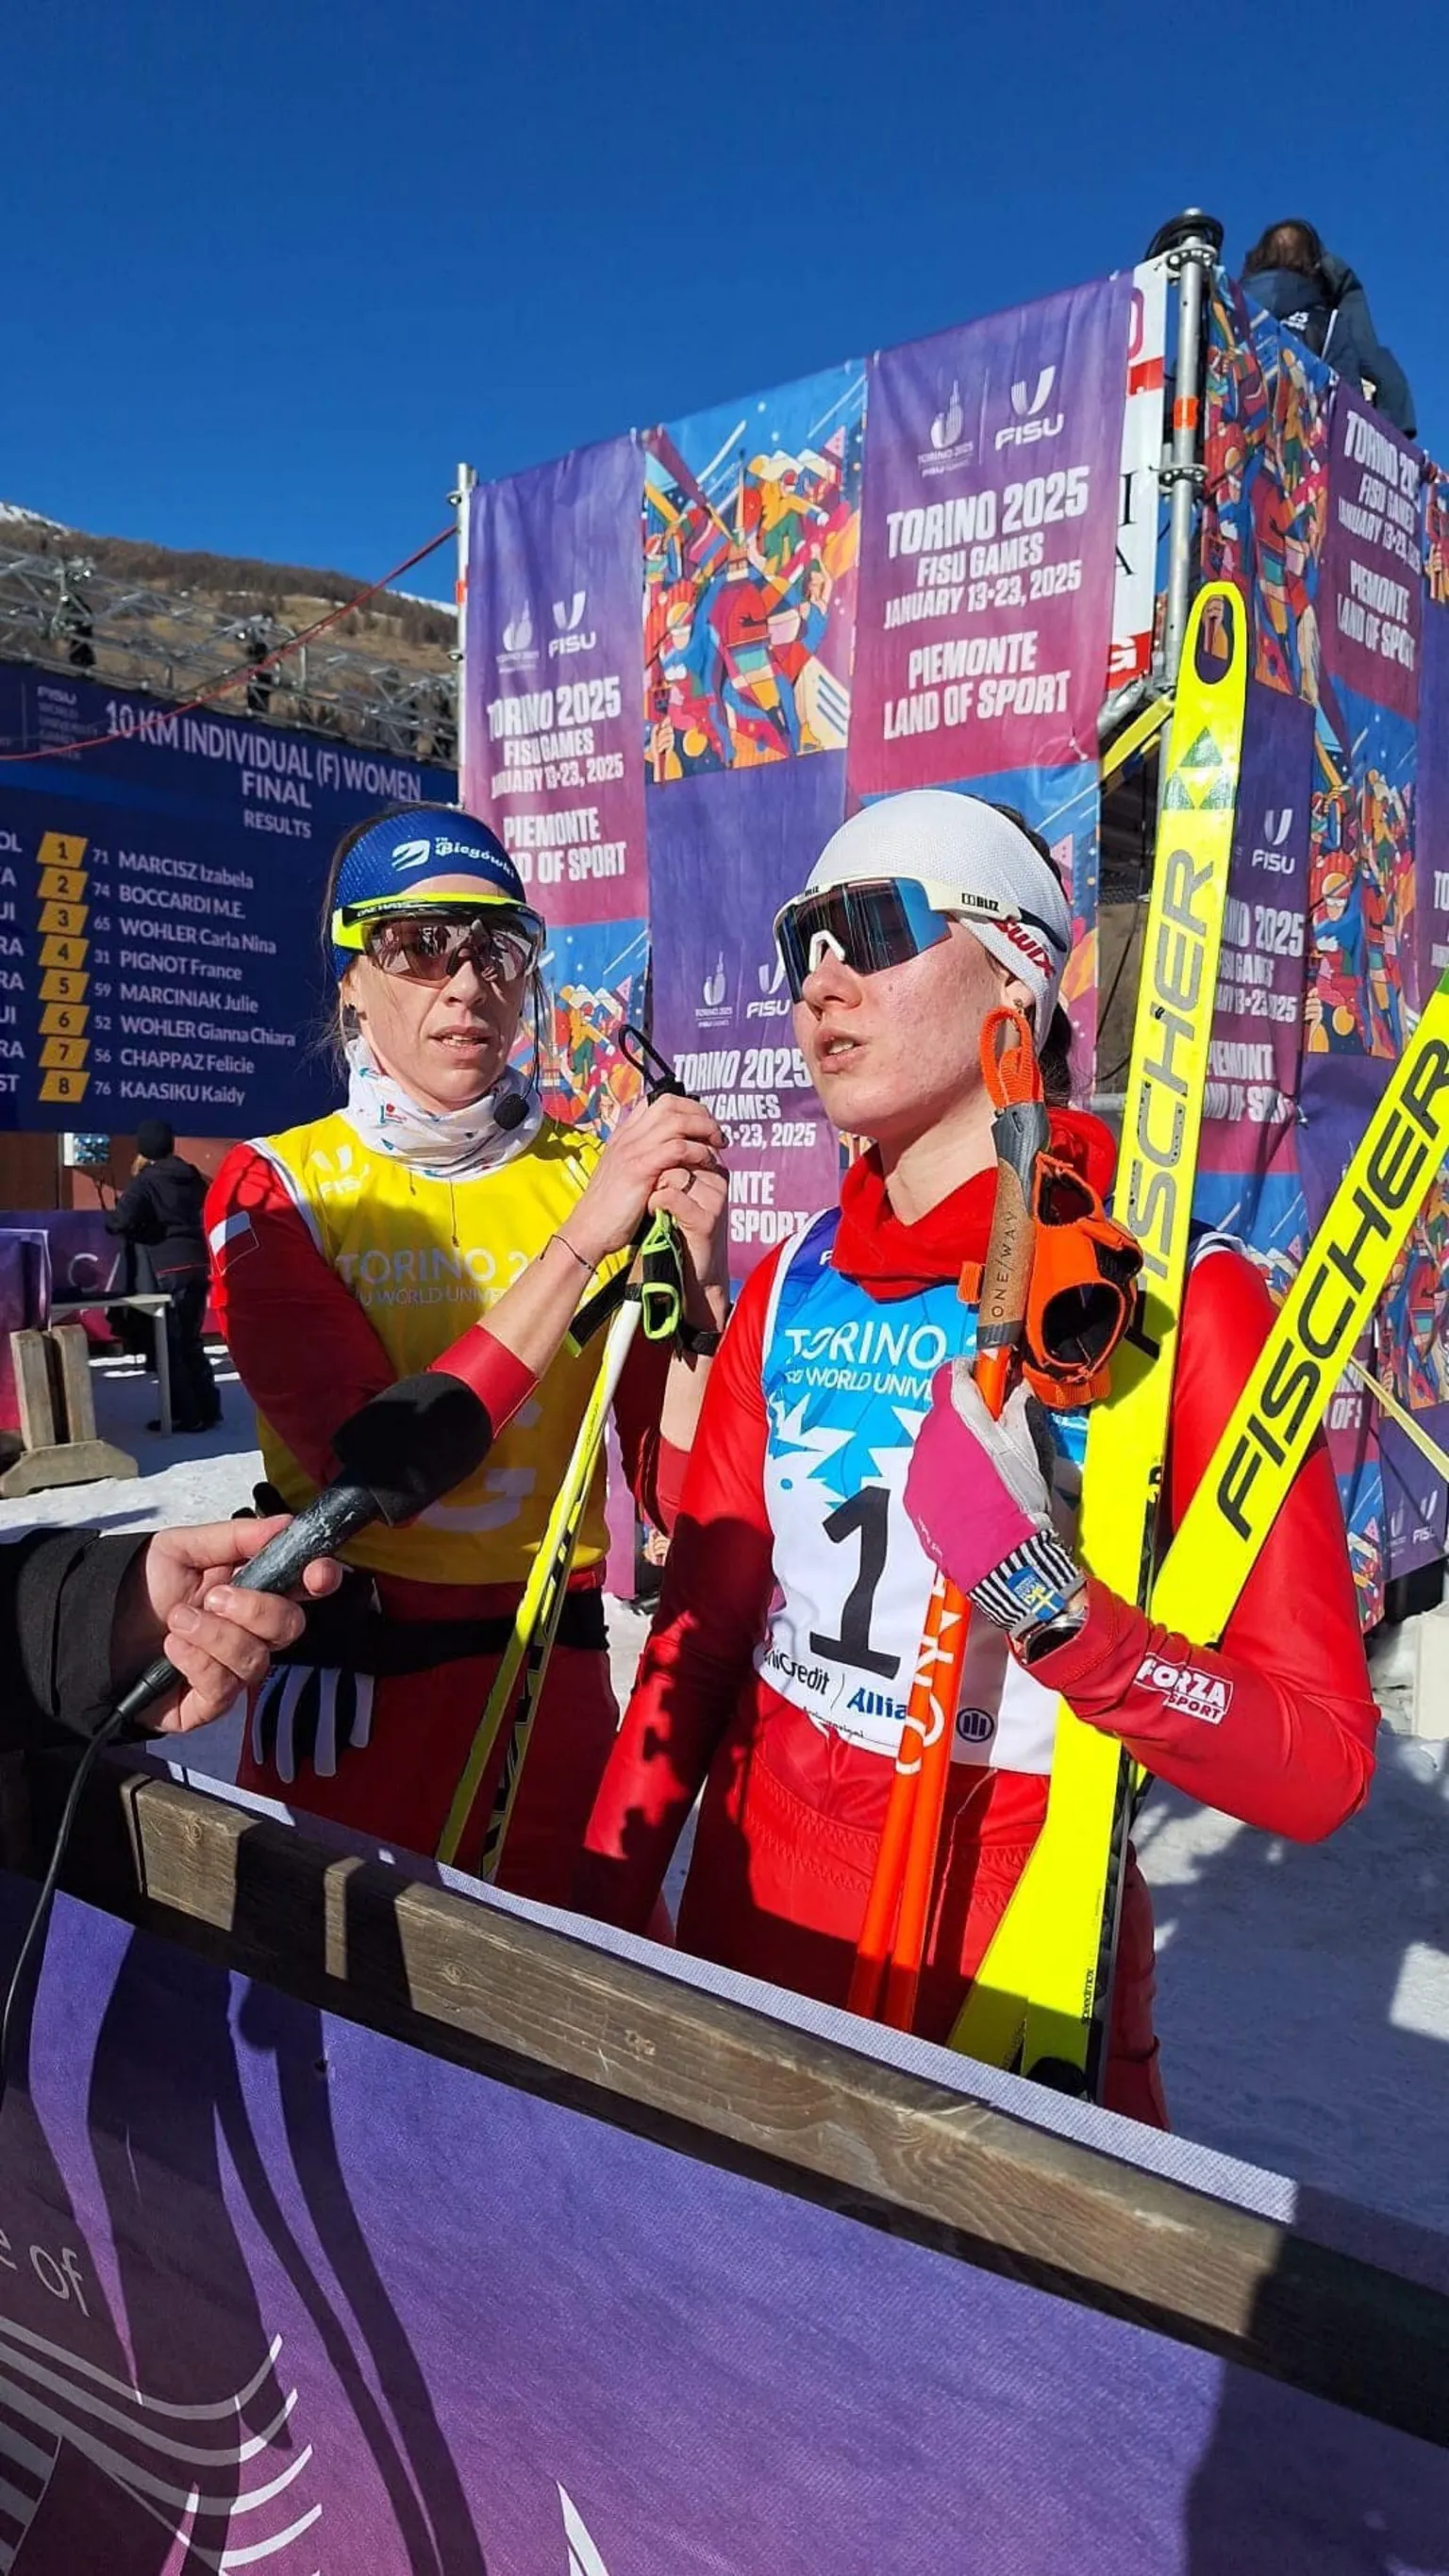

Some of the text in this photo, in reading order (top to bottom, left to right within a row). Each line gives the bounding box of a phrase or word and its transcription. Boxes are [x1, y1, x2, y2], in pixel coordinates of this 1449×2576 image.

[995, 413, 1065, 451] FISU
[1343, 409, 1399, 487] TORINO
[886, 465, 1091, 559] TORINO 2025
[1358, 473, 1387, 513] FISU
[917, 532, 1044, 589] FISU GAMES
[884, 587, 963, 631] JANUARY
[1030, 559, 1083, 598] 2025
[548, 631, 596, 658] FISU
[1365, 612, 1380, 653] OF
[908, 630, 1039, 690] PIEMONTE
[487, 675, 622, 741] TORINO 2025
[883, 671, 1072, 741] LAND OF SPORT
[105, 699, 135, 740] 10
[140, 708, 179, 749] KM
[184, 718, 314, 781] INDIVIDUAL
[316, 748, 341, 791] (F)
[341, 756, 422, 802] WOMEN
[504, 727, 595, 766] FISU GAMES
[586, 753, 625, 784] 2025
[242, 770, 312, 808] FINAL
[242, 808, 312, 839] RESULTS
[503, 807, 601, 849] PIEMONTE
[58, 840, 68, 859] 1
[92, 848, 110, 865] 71
[118, 850, 198, 881] MARCISZ
[199, 863, 255, 890] Izabela
[538, 850, 565, 884] OF
[568, 841, 627, 881] SPORT
[1251, 849, 1296, 875] FISU
[0, 866, 17, 888] A
[57, 875, 69, 893] 2
[92, 882, 110, 898] 74
[119, 884, 210, 914] BOCCARDI
[58, 909, 69, 927] 3
[93, 915, 110, 932] 65
[119, 917, 197, 944] WOHLER
[198, 928, 240, 951] Carla
[241, 932, 276, 955] Nina
[1254, 905, 1307, 958] 2025
[58, 943, 69, 960] 4
[119, 950, 188, 975] PIGNOT
[190, 957, 243, 981] France
[58, 977, 70, 994] 5
[94, 982, 111, 998] 59
[120, 981, 222, 1010] MARCINIAK
[224, 993, 259, 1014] Julie
[746, 999, 791, 1019] FISU
[58, 1011, 70, 1028] 6
[94, 1015, 111, 1031] 52
[120, 1014, 196, 1039] WOHLER
[196, 1022, 249, 1044] Gianna
[249, 1026, 297, 1048] Chiara
[58, 1043, 70, 1060] 7
[94, 1048, 111, 1064] 56
[120, 1047, 205, 1072] CHAPPAZ
[206, 1053, 256, 1074] Felicie
[674, 1048, 813, 1093] TORINO 2025
[58, 1077, 70, 1095] 8
[94, 1080, 111, 1096] 76
[120, 1080, 200, 1103] KAASIKU
[201, 1085, 246, 1106] Kaidy
[714, 1094, 782, 1121] GAMES
[771, 1122, 817, 1148] 2025
[334, 1246, 496, 1286] TORINO
[376, 1287, 445, 1305] WORLD
[1216, 1038, 1449, 1541] FISCHER
[785, 1321, 947, 1370] TORINO
[804, 1368, 873, 1392] WORLD
[808, 1484, 901, 1681] 1
[1136, 1657, 1226, 1709] FORZA
[846, 1687, 908, 1720] Allia
[1168, 1693, 1222, 1720] SPORT
[29, 2244, 91, 2317] of
